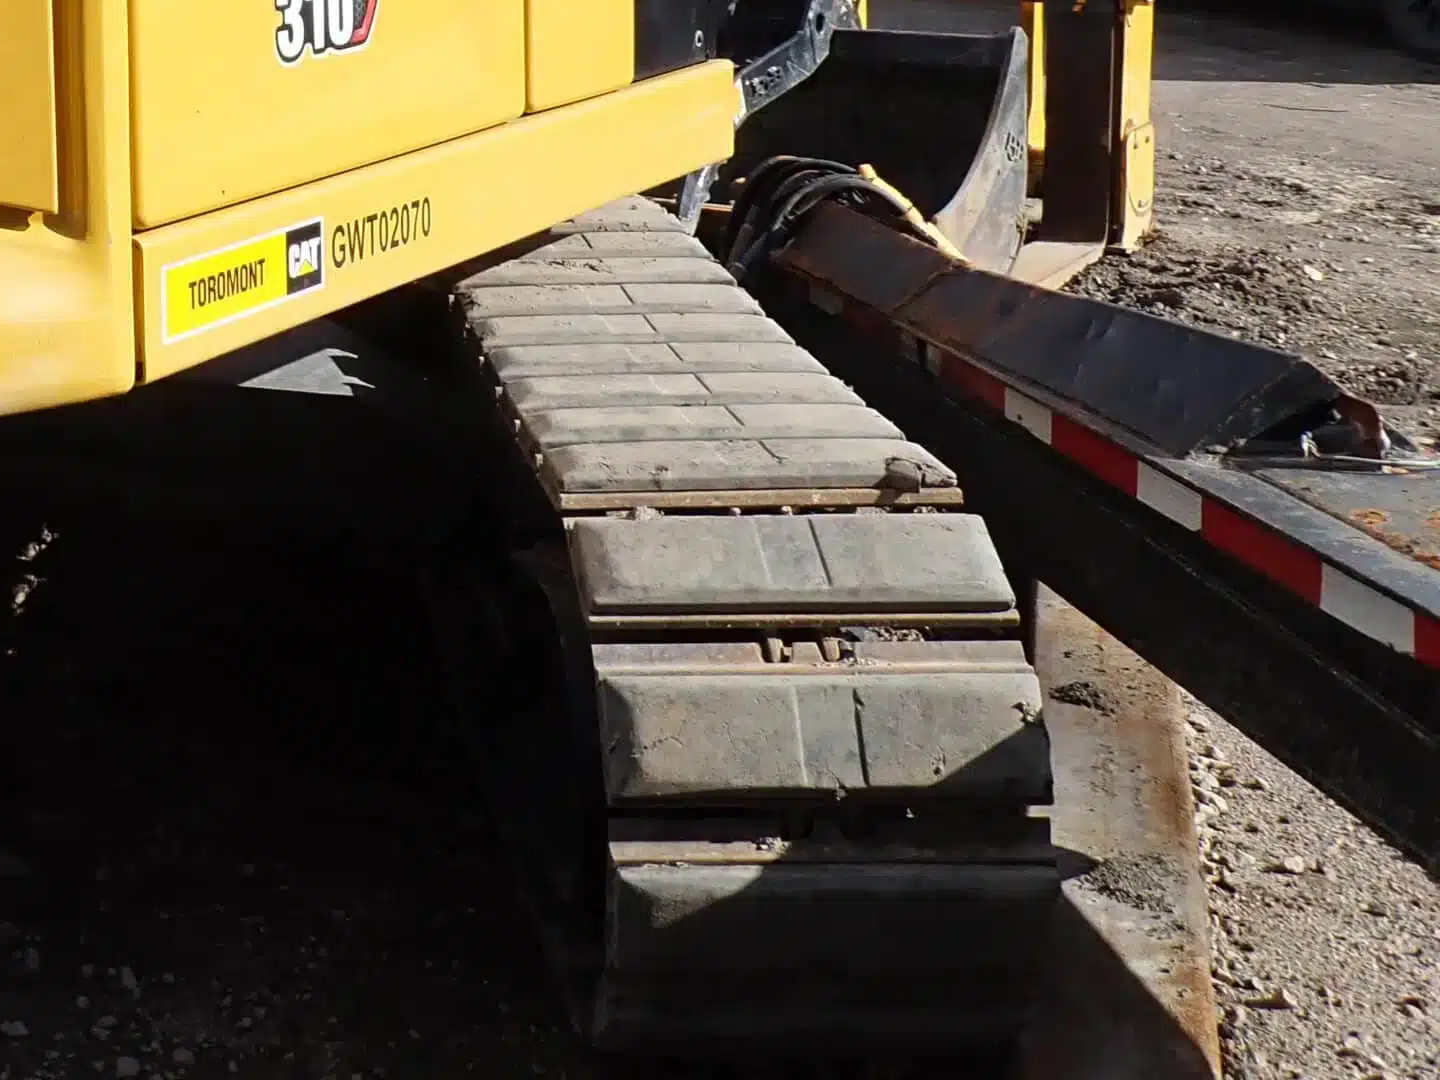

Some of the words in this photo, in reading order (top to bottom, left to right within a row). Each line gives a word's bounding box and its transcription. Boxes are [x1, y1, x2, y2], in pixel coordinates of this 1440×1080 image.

[331, 196, 431, 269] GWT02070
[188, 258, 266, 310] TOROMONT
[288, 236, 321, 279] CAT
